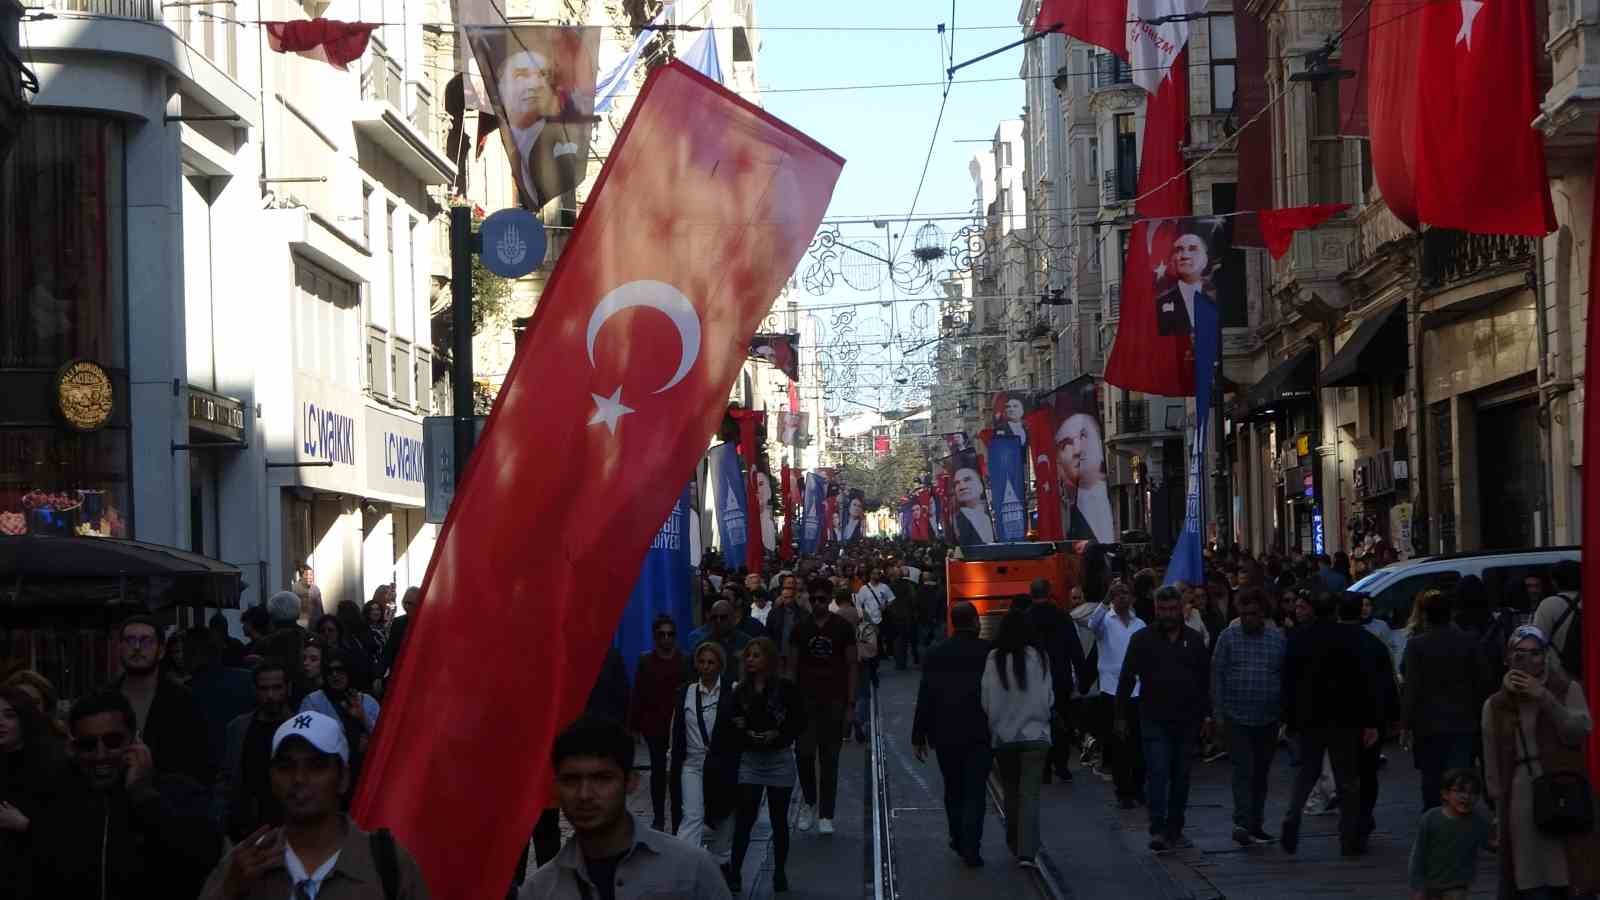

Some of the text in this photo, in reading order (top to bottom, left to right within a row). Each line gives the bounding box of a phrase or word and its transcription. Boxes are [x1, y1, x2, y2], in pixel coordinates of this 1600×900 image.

[303, 401, 317, 456] LC
[384, 431, 396, 478] LC
[293, 714, 313, 729] NY
